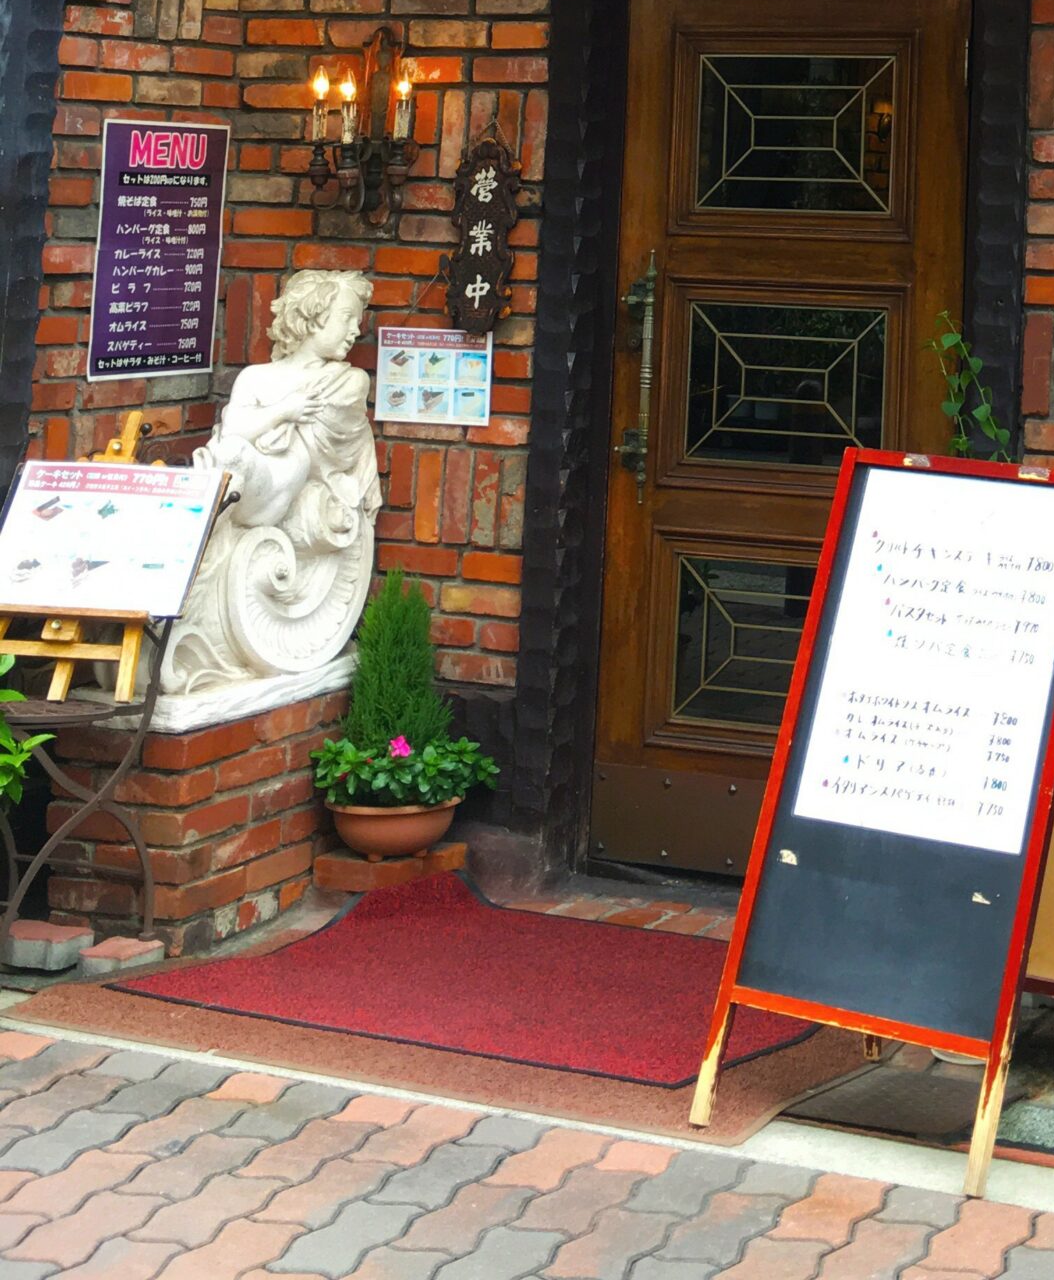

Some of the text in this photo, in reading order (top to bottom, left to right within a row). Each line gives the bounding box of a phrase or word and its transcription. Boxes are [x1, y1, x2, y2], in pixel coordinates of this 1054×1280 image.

[129, 130, 207, 170] MENU
[117, 195, 208, 208] 焼そば定食 750円
[116, 223, 206, 236] ハンバーグ定食 800円
[114, 248, 161, 260] カレーライス
[112, 263, 203, 277] ハンバーグカレー 900円
[108, 318, 199, 333] オムライス 750円
[386, 333, 415, 341] ケーキセット
[107, 337, 197, 352] スパゲティー 750円
[97, 353, 203, 369] セットはサラダ・みそ汁・コーヒー付
[35, 468, 84, 482] ケーキセット
